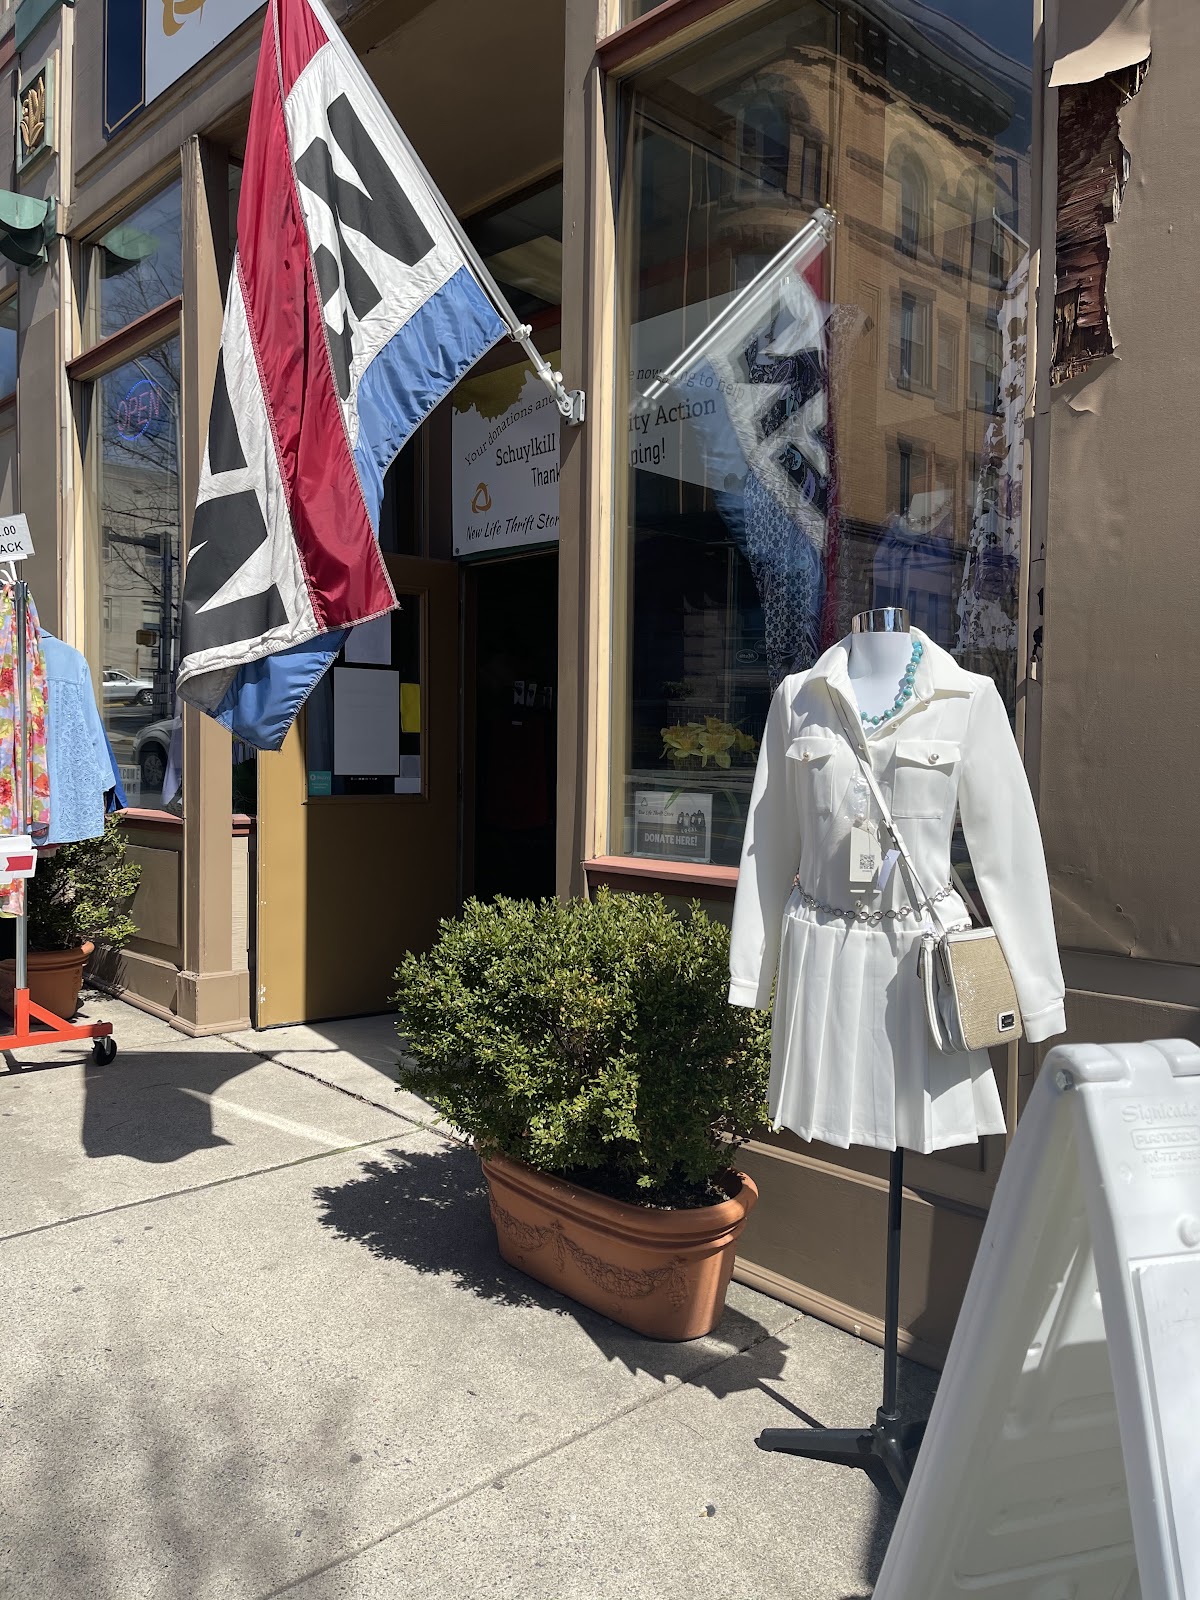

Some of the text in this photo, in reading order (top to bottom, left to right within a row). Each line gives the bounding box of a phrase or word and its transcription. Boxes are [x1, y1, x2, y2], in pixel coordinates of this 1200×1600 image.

[117, 386, 161, 431] OPEN
[464, 442, 487, 466] Your
[488, 404, 533, 446] donations
[699, 374, 714, 388] to
[716, 378, 746, 402] help
[496, 433, 557, 467] Schuylkill
[655, 397, 717, 427] Action
[0, 525, 16, 537] .00
[466, 526, 483, 541] New
[484, 519, 502, 541] Life
[505, 515, 535, 536] Thrift
[644, 832, 698, 846] DONATE HERE!
